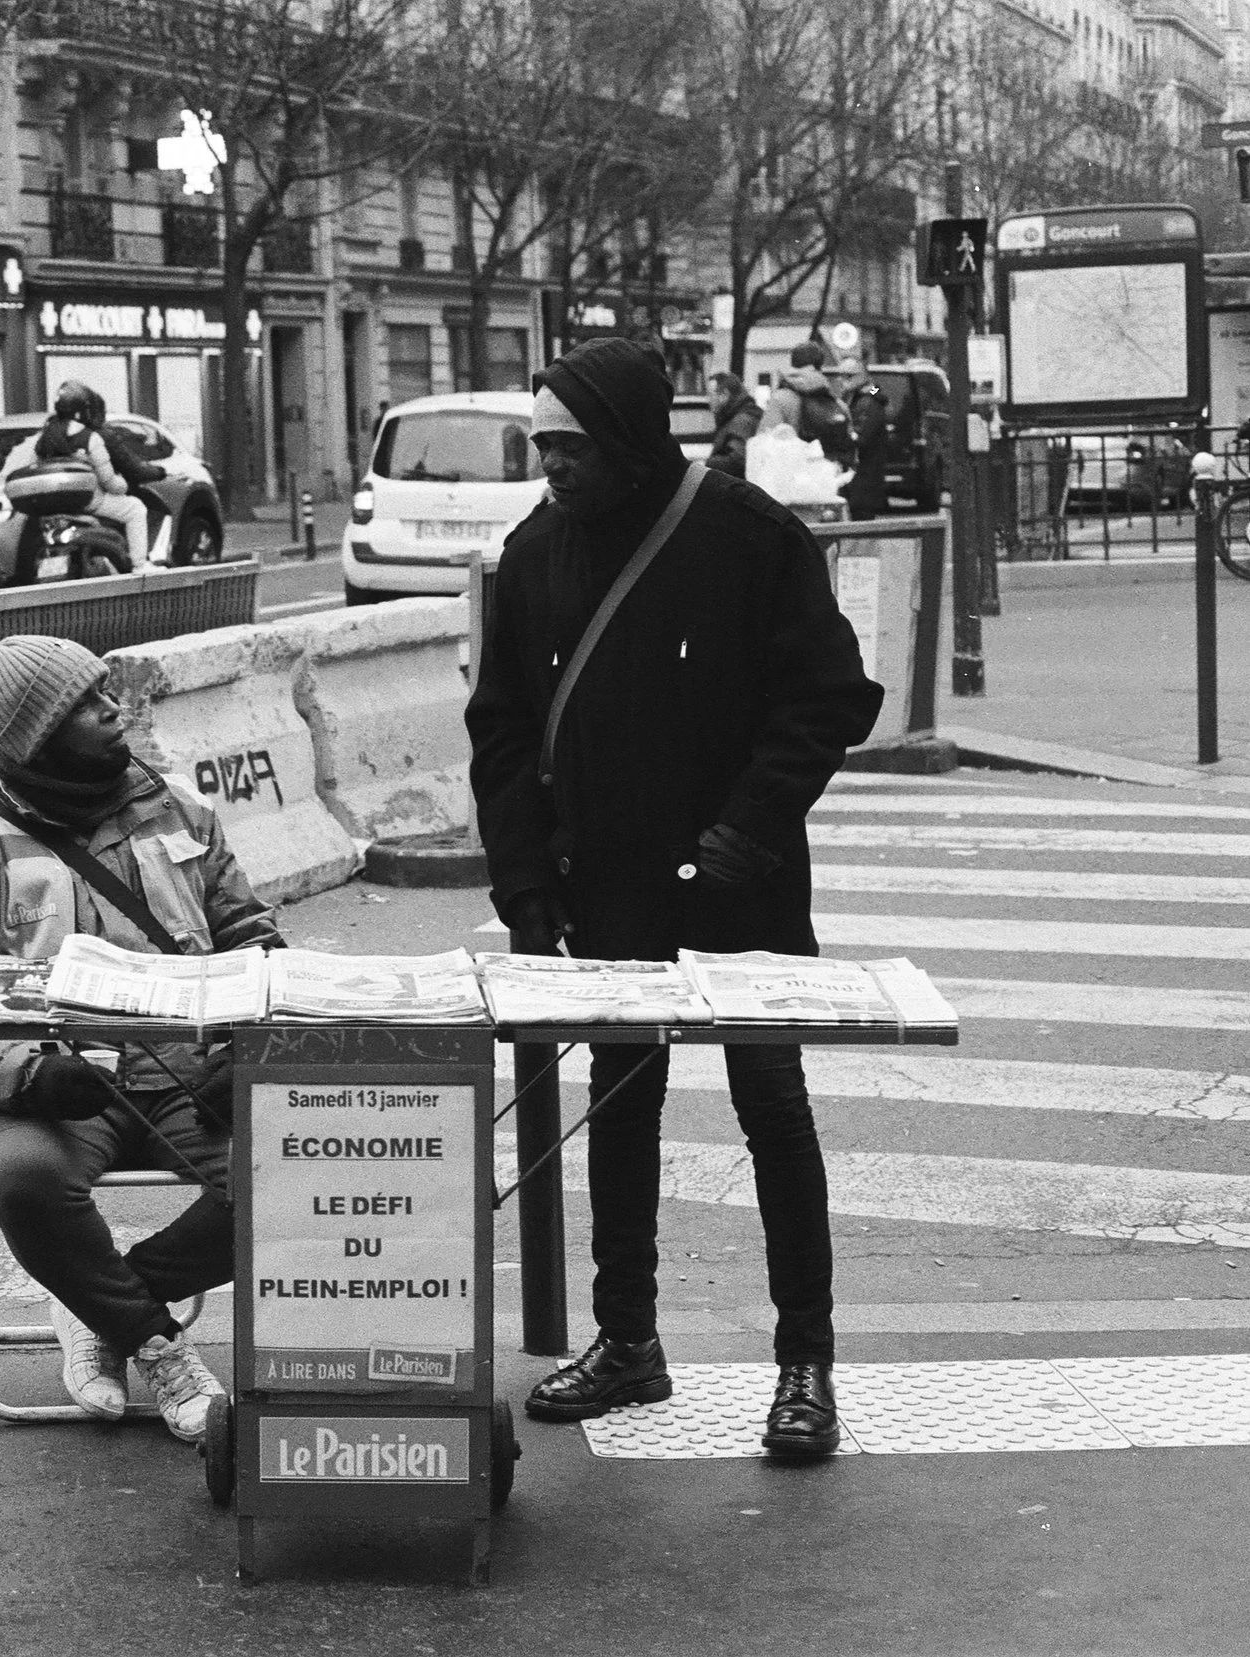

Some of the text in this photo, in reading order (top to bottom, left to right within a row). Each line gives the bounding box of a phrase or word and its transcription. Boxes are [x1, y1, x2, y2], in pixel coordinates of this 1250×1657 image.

[1049, 223, 1121, 241] Goncourt
[288, 1090, 440, 1112] Samedi 13 janvier
[282, 1132, 443, 1158] ÉCONOMIE
[313, 1191, 412, 1215] LE DÉFI
[344, 1237, 382, 1257] DU
[259, 1278, 449, 1299] PLEIN-EMPLOI
[267, 1358, 356, 1380] À LIRE DANS
[394, 1354, 443, 1376] Parisien
[280, 1427, 448, 1477] Le Parisien
